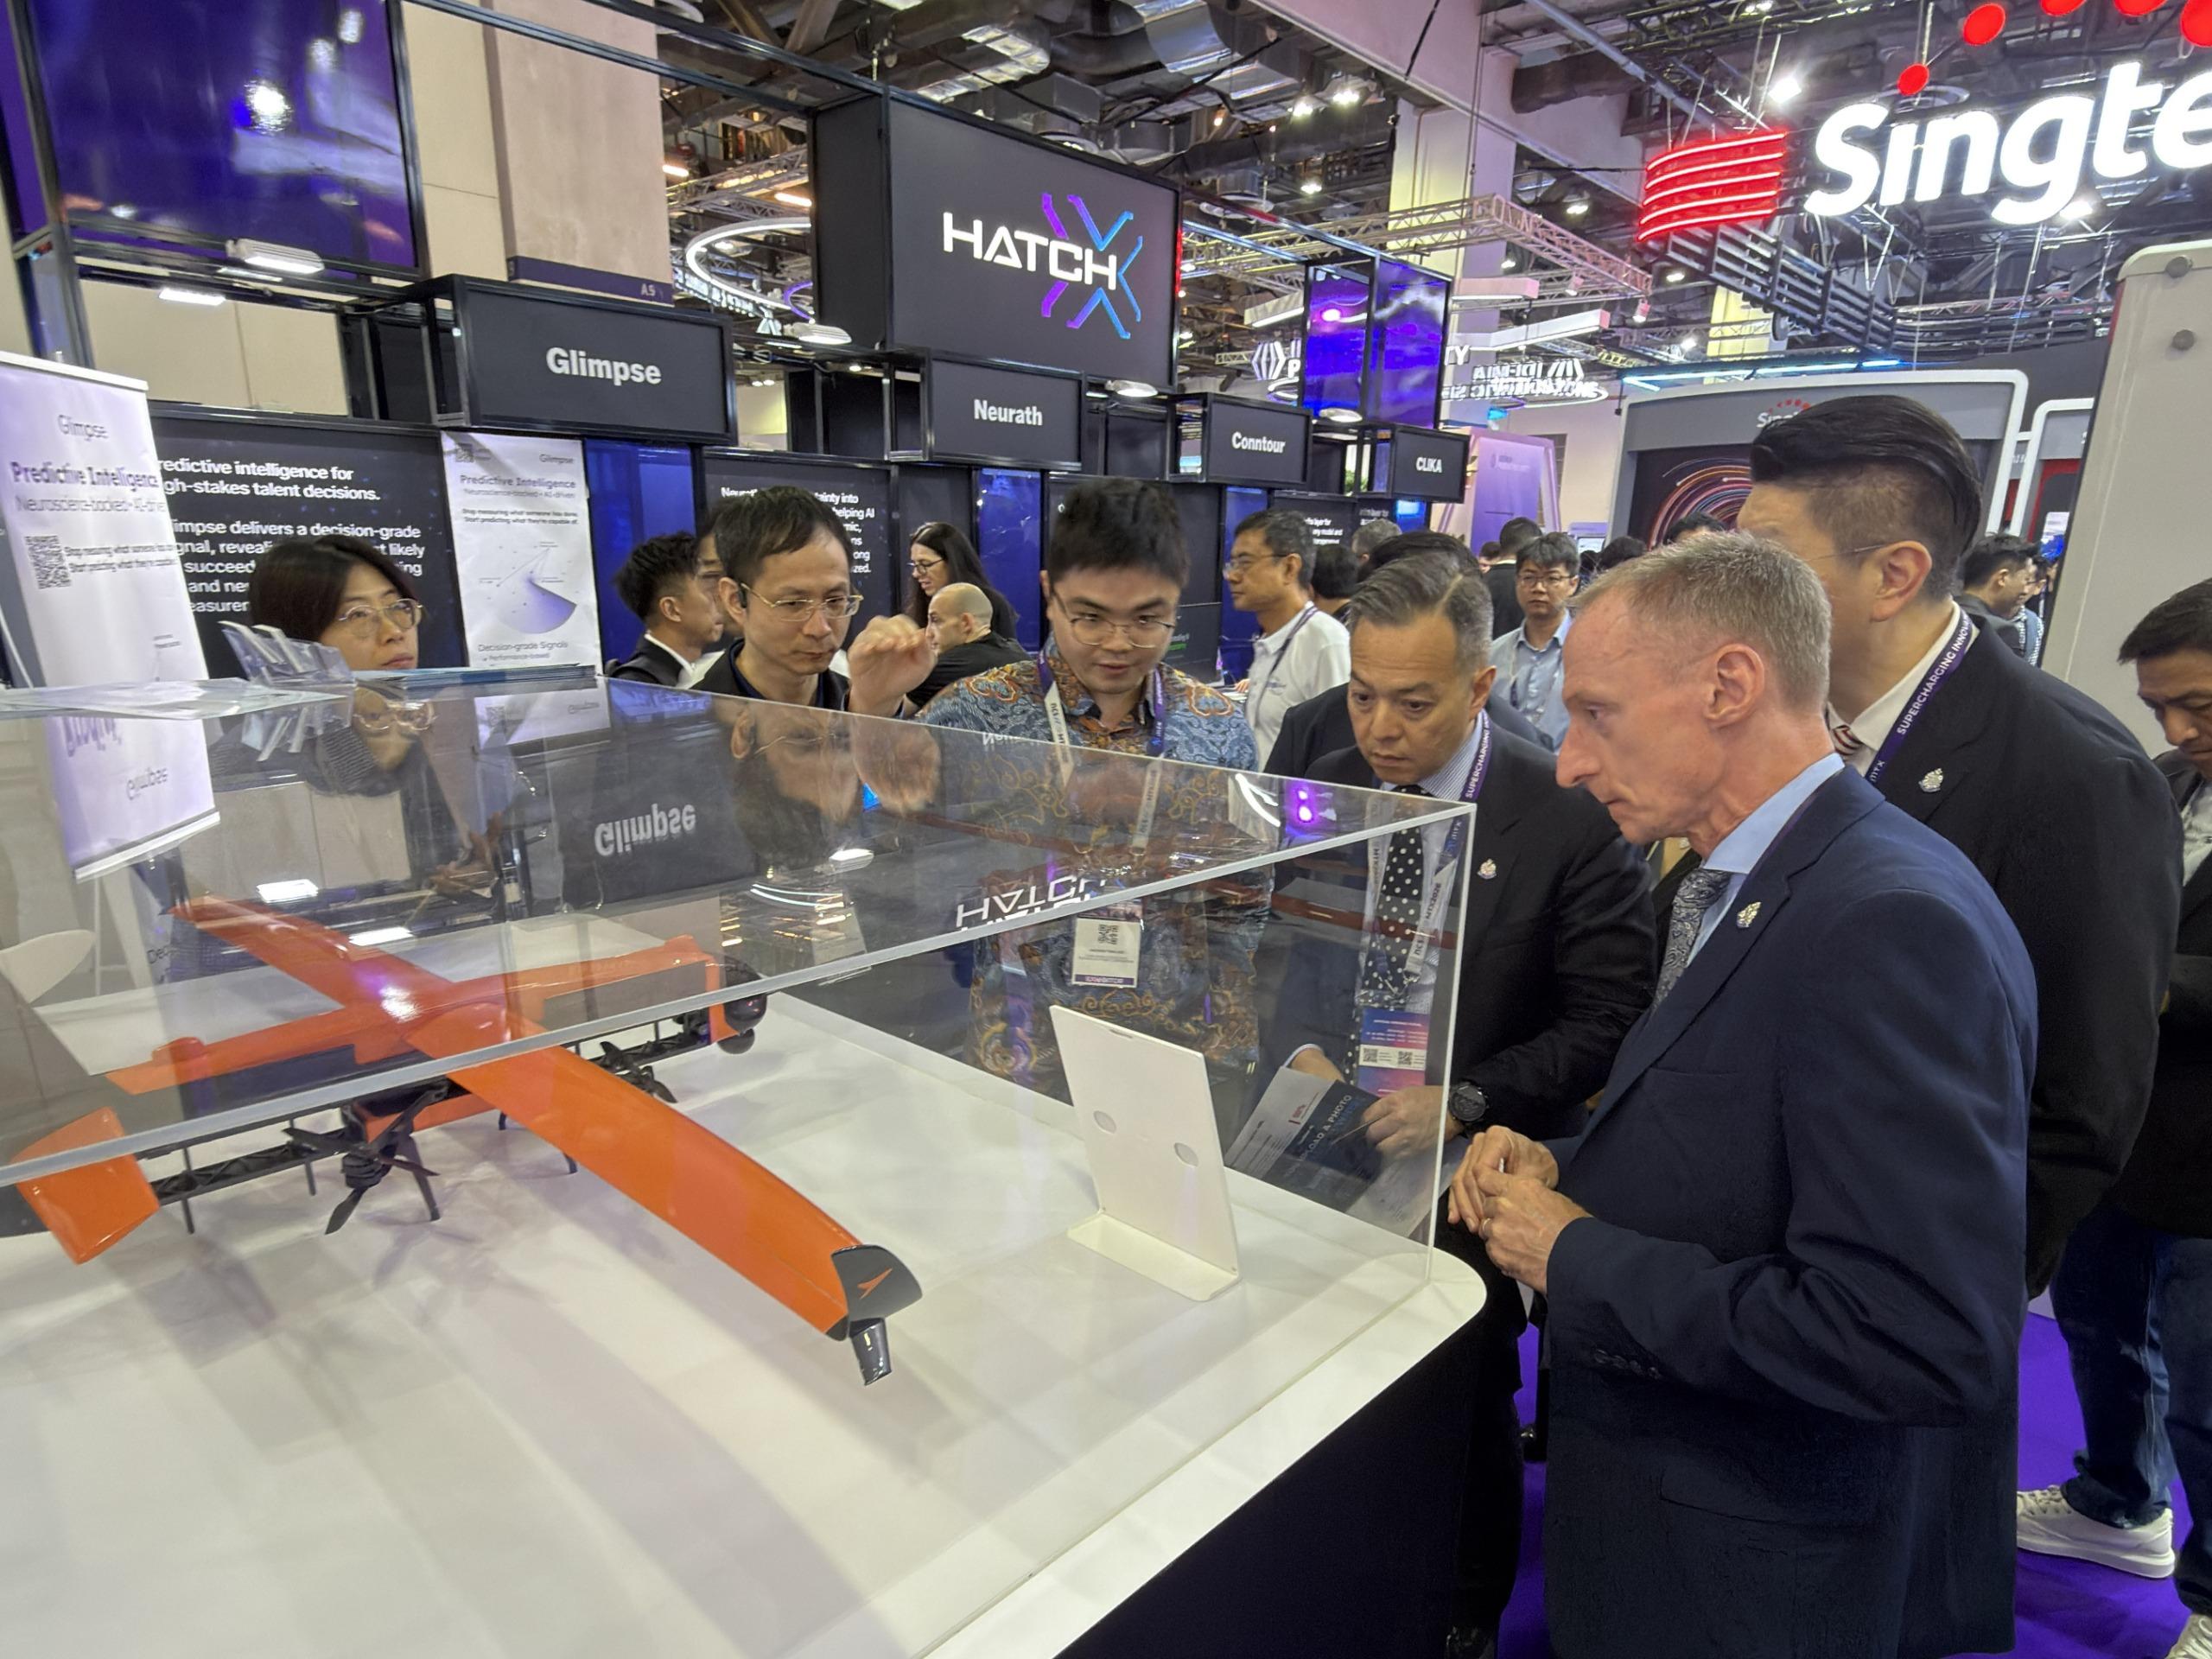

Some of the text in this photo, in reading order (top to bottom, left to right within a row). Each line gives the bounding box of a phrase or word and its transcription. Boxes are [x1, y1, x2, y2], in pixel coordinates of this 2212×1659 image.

[944, 212, 1117, 290] HATCH
[546, 346, 662, 386] Glimpse
[974, 398, 1044, 426] Neurath
[1231, 431, 1286, 454] Conntour
[158, 458, 354, 480] redictive intelligence for
[1415, 456, 1443, 474] CLIKA
[163, 478, 381, 500] gh-stakes talent decisions.
[460, 474, 576, 490] Predictive Intelligence
[841, 493, 859, 504] into
[866, 508, 874, 518] AI
[173, 518, 422, 540] impse delivers a decision-grade
[175, 539, 216, 556] gnal,
[387, 543, 425, 558] likely
[183, 559, 257, 573] succeed
[188, 579, 221, 592] and
[1897, 651, 1956, 735] SUPERCHARGING
[1465, 729, 1491, 798] SUPERCHARGING
[1328, 1094, 1352, 1124] PHOTO
